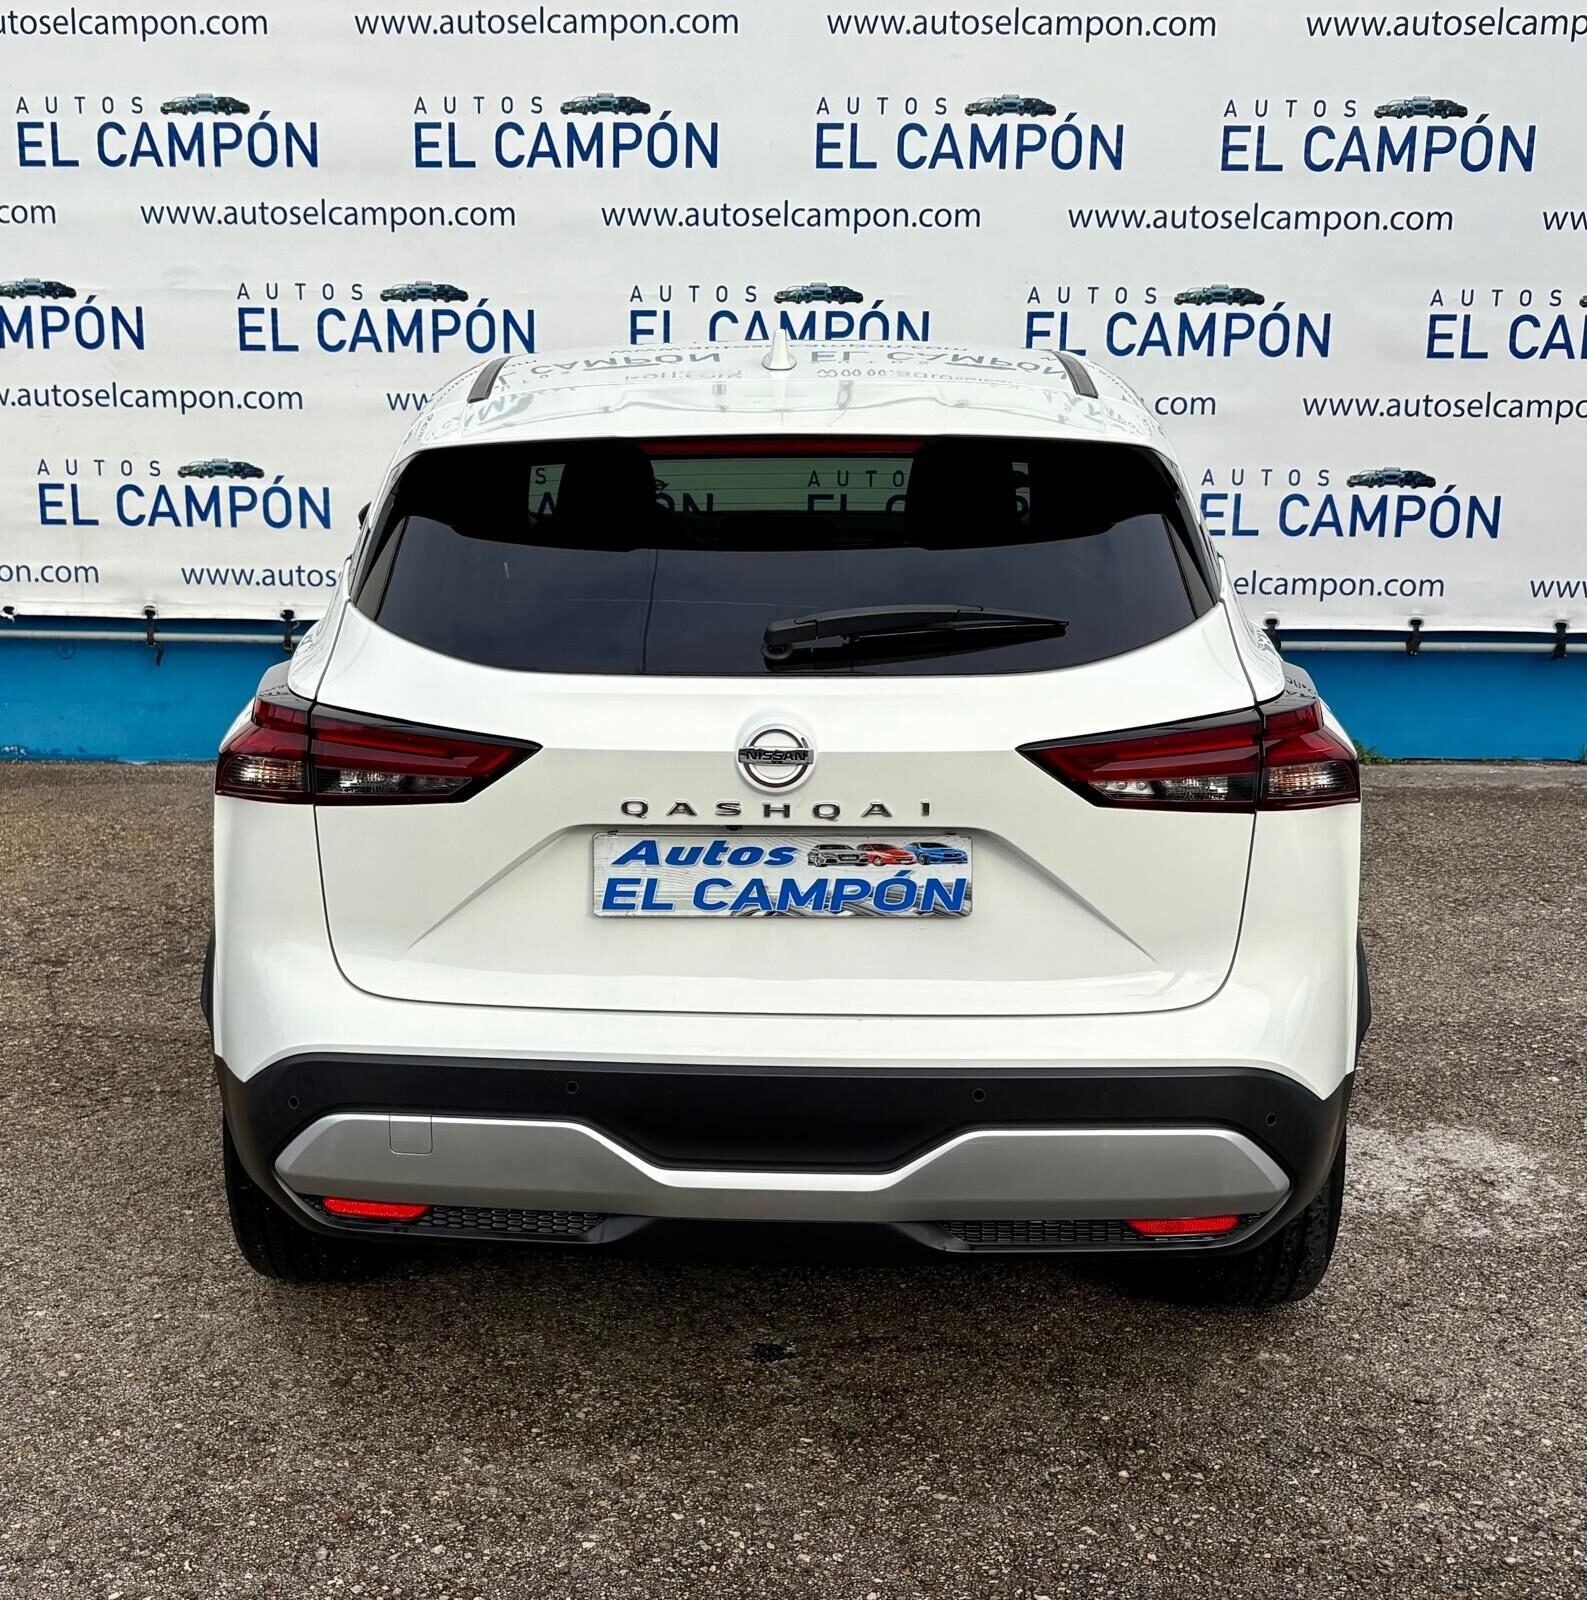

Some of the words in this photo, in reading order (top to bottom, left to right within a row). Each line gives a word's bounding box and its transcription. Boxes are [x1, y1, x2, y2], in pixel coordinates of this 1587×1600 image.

[355, 6, 738, 41] www.autoselcampon.com
[827, 7, 1215, 43] www.autoselcampon.com
[16, 96, 142, 114] AUTOS
[414, 96, 542, 114] AUTOS
[817, 97, 946, 115] AUTOS
[1224, 100, 1356, 117] AUTOS
[17, 122, 79, 167] EL
[98, 111, 318, 167] CAMPÓN
[415, 122, 476, 168] EL
[495, 111, 718, 168] CAMPÓN
[816, 123, 877, 169] EL
[897, 113, 1123, 170] CAMPÓN
[1221, 126, 1283, 171] EL
[1304, 114, 1536, 172] CAMPÓN
[141, 199, 515, 232] www.autoselcampon.com
[602, 200, 980, 234] www.autoselcampon.com
[1069, 203, 1452, 237] www.autoselcampon.com
[237, 283, 362, 300] AUTOS
[630, 285, 756, 302] AUTOS
[1027, 287, 1156, 304] AUTOS
[1430, 289, 1561, 306] AUTOS
[238, 307, 299, 352] EL
[317, 298, 535, 353] CAMPÓN
[709, 300, 929, 341] CAMPÓN
[1026, 312, 1086, 357] EL
[1107, 302, 1331, 357] CAMPÓN
[1427, 314, 1488, 359] EL
[1509, 314, 1587, 359] CA
[38, 459, 160, 476] AUTOS
[1202, 469, 1329, 486] AUTOS
[39, 483, 99, 526] EL
[117, 475, 330, 529] CAMPÓN
[1200, 492, 1262, 538] EL
[1279, 485, 1501, 538] CAMPÓN
[746, 750, 807, 761] NISSAN
[620, 799, 932, 820] QASHQAI
[612, 840, 796, 865] Autos
[602, 877, 673, 910] EL
[692, 870, 966, 912] CAMPÓN
